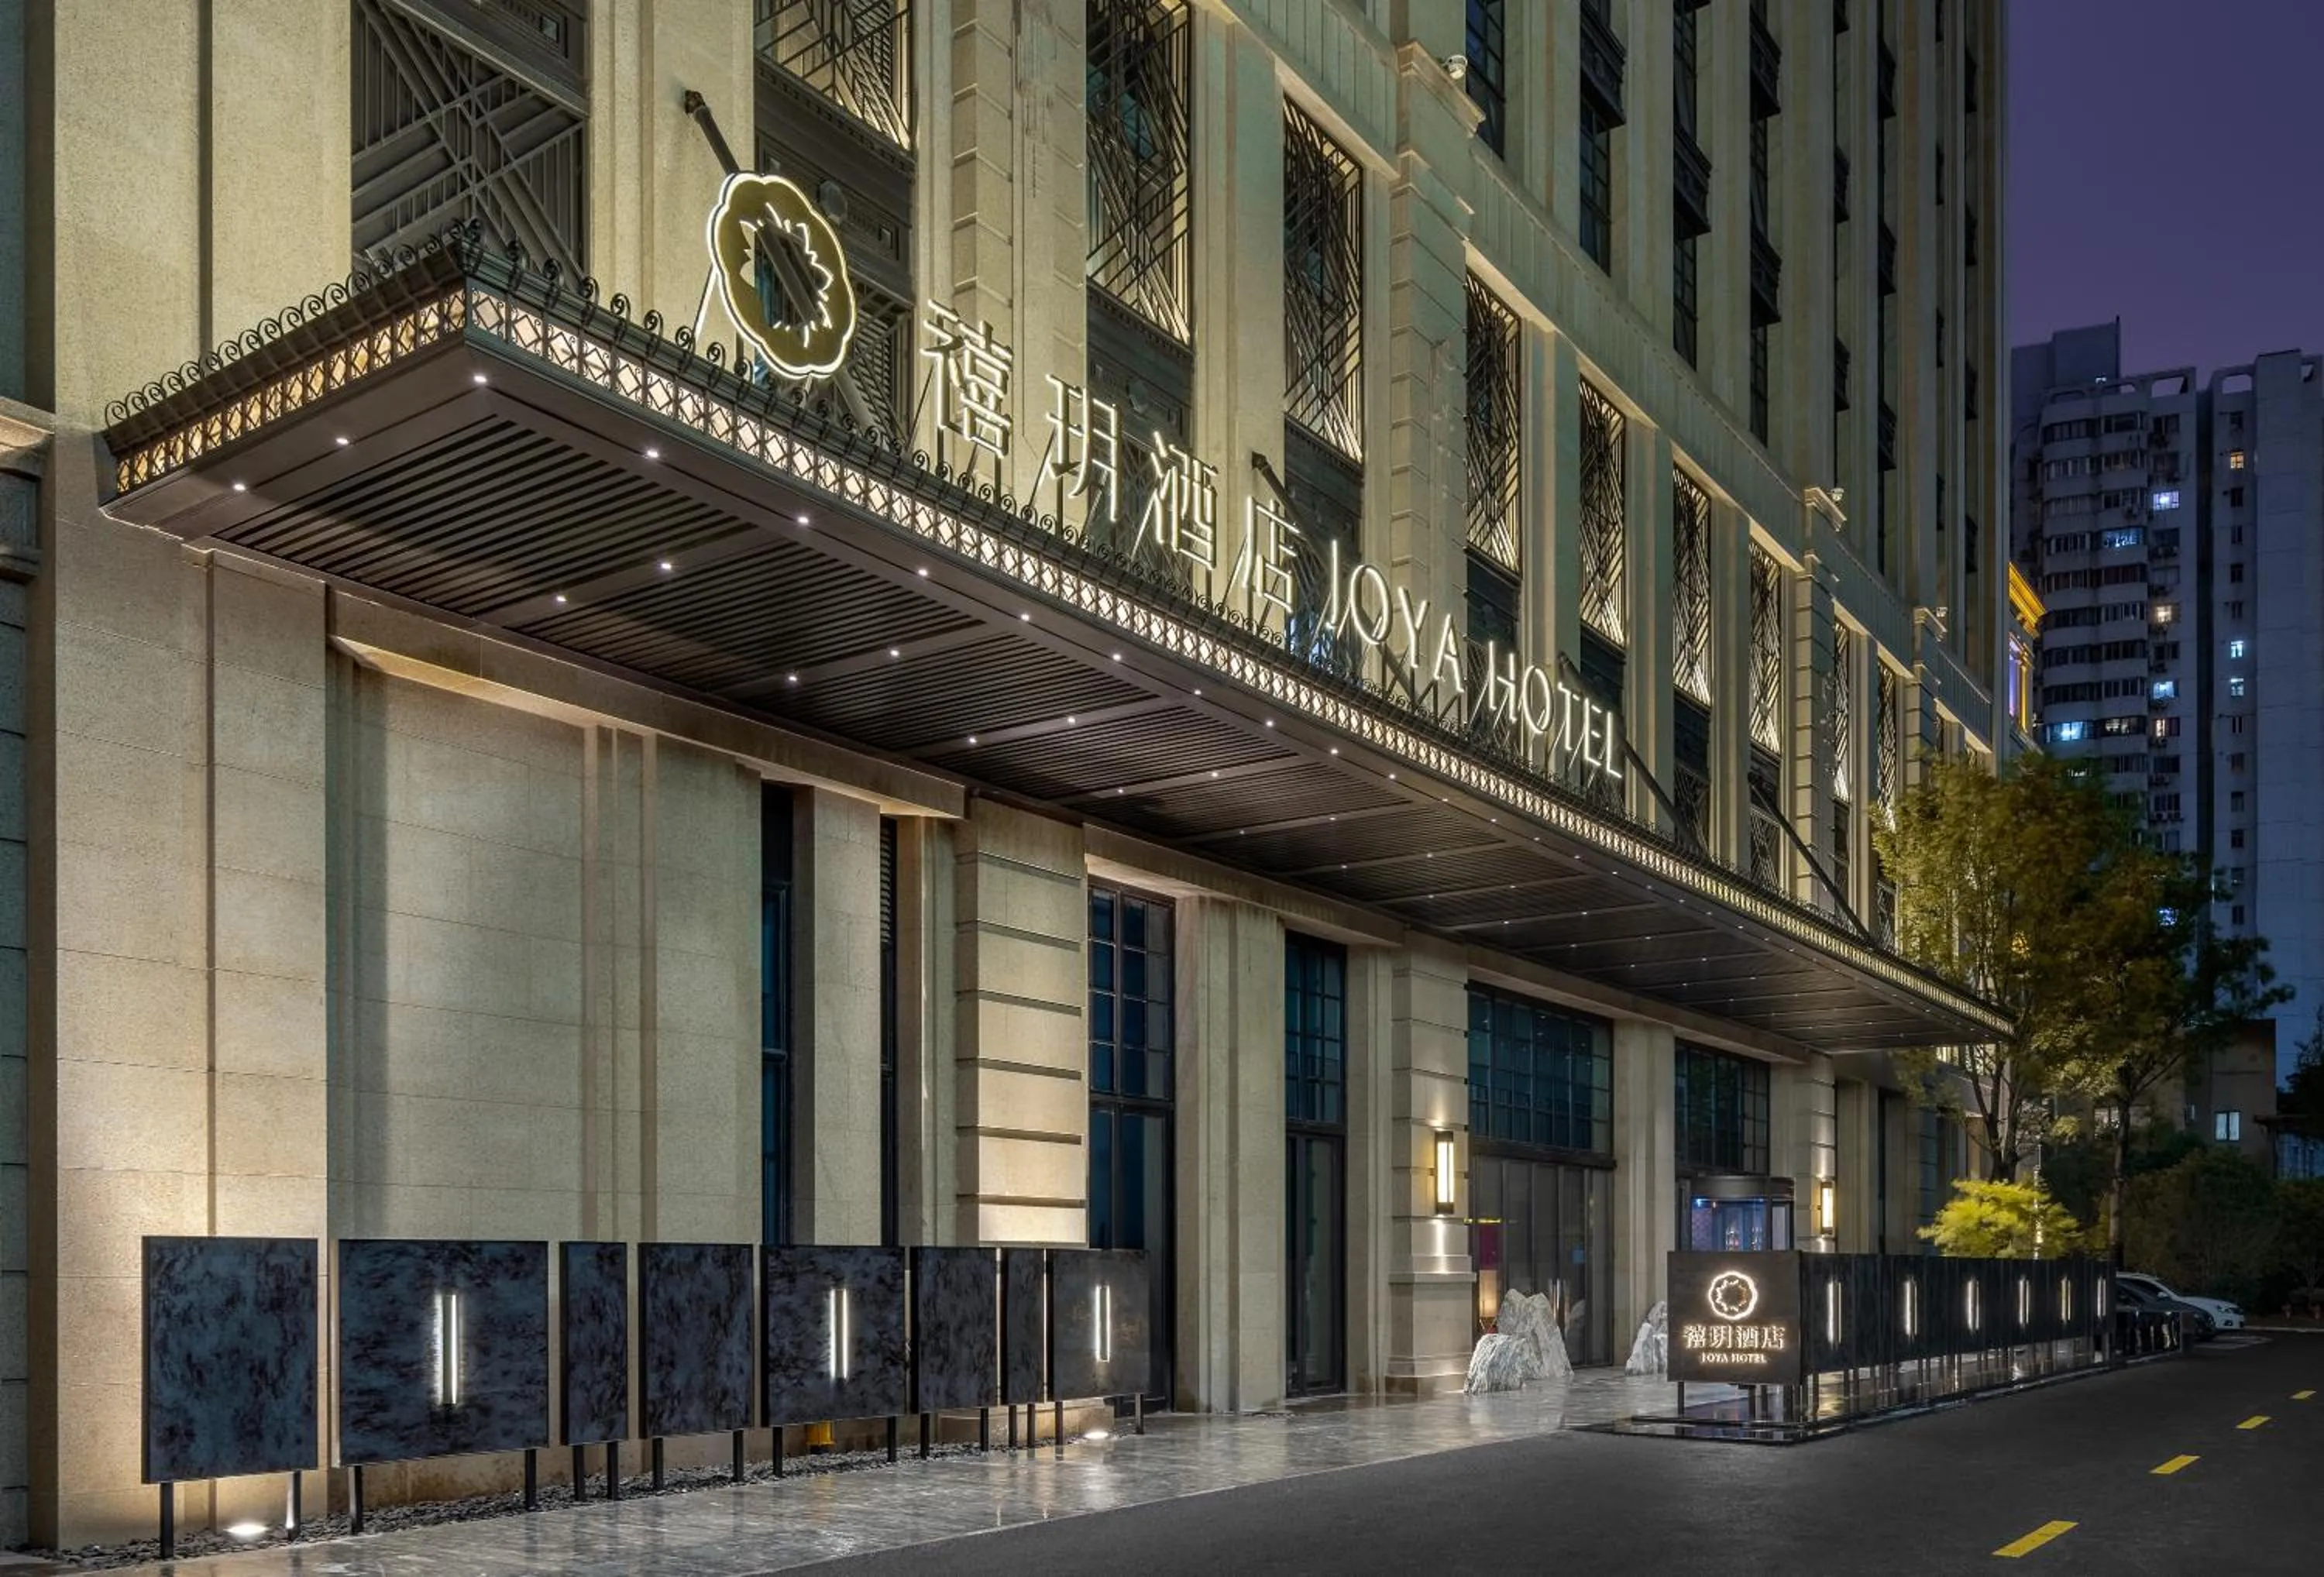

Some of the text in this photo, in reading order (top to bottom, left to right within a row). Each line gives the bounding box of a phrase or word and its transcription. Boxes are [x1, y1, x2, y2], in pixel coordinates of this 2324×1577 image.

[920, 298, 1301, 614] 禧玥酒店
[1325, 539, 1622, 778] JOYA HOTEL
[1683, 1324, 1786, 1349] 禧玥酒店
[1731, 1352, 1768, 1363] HOTEL
